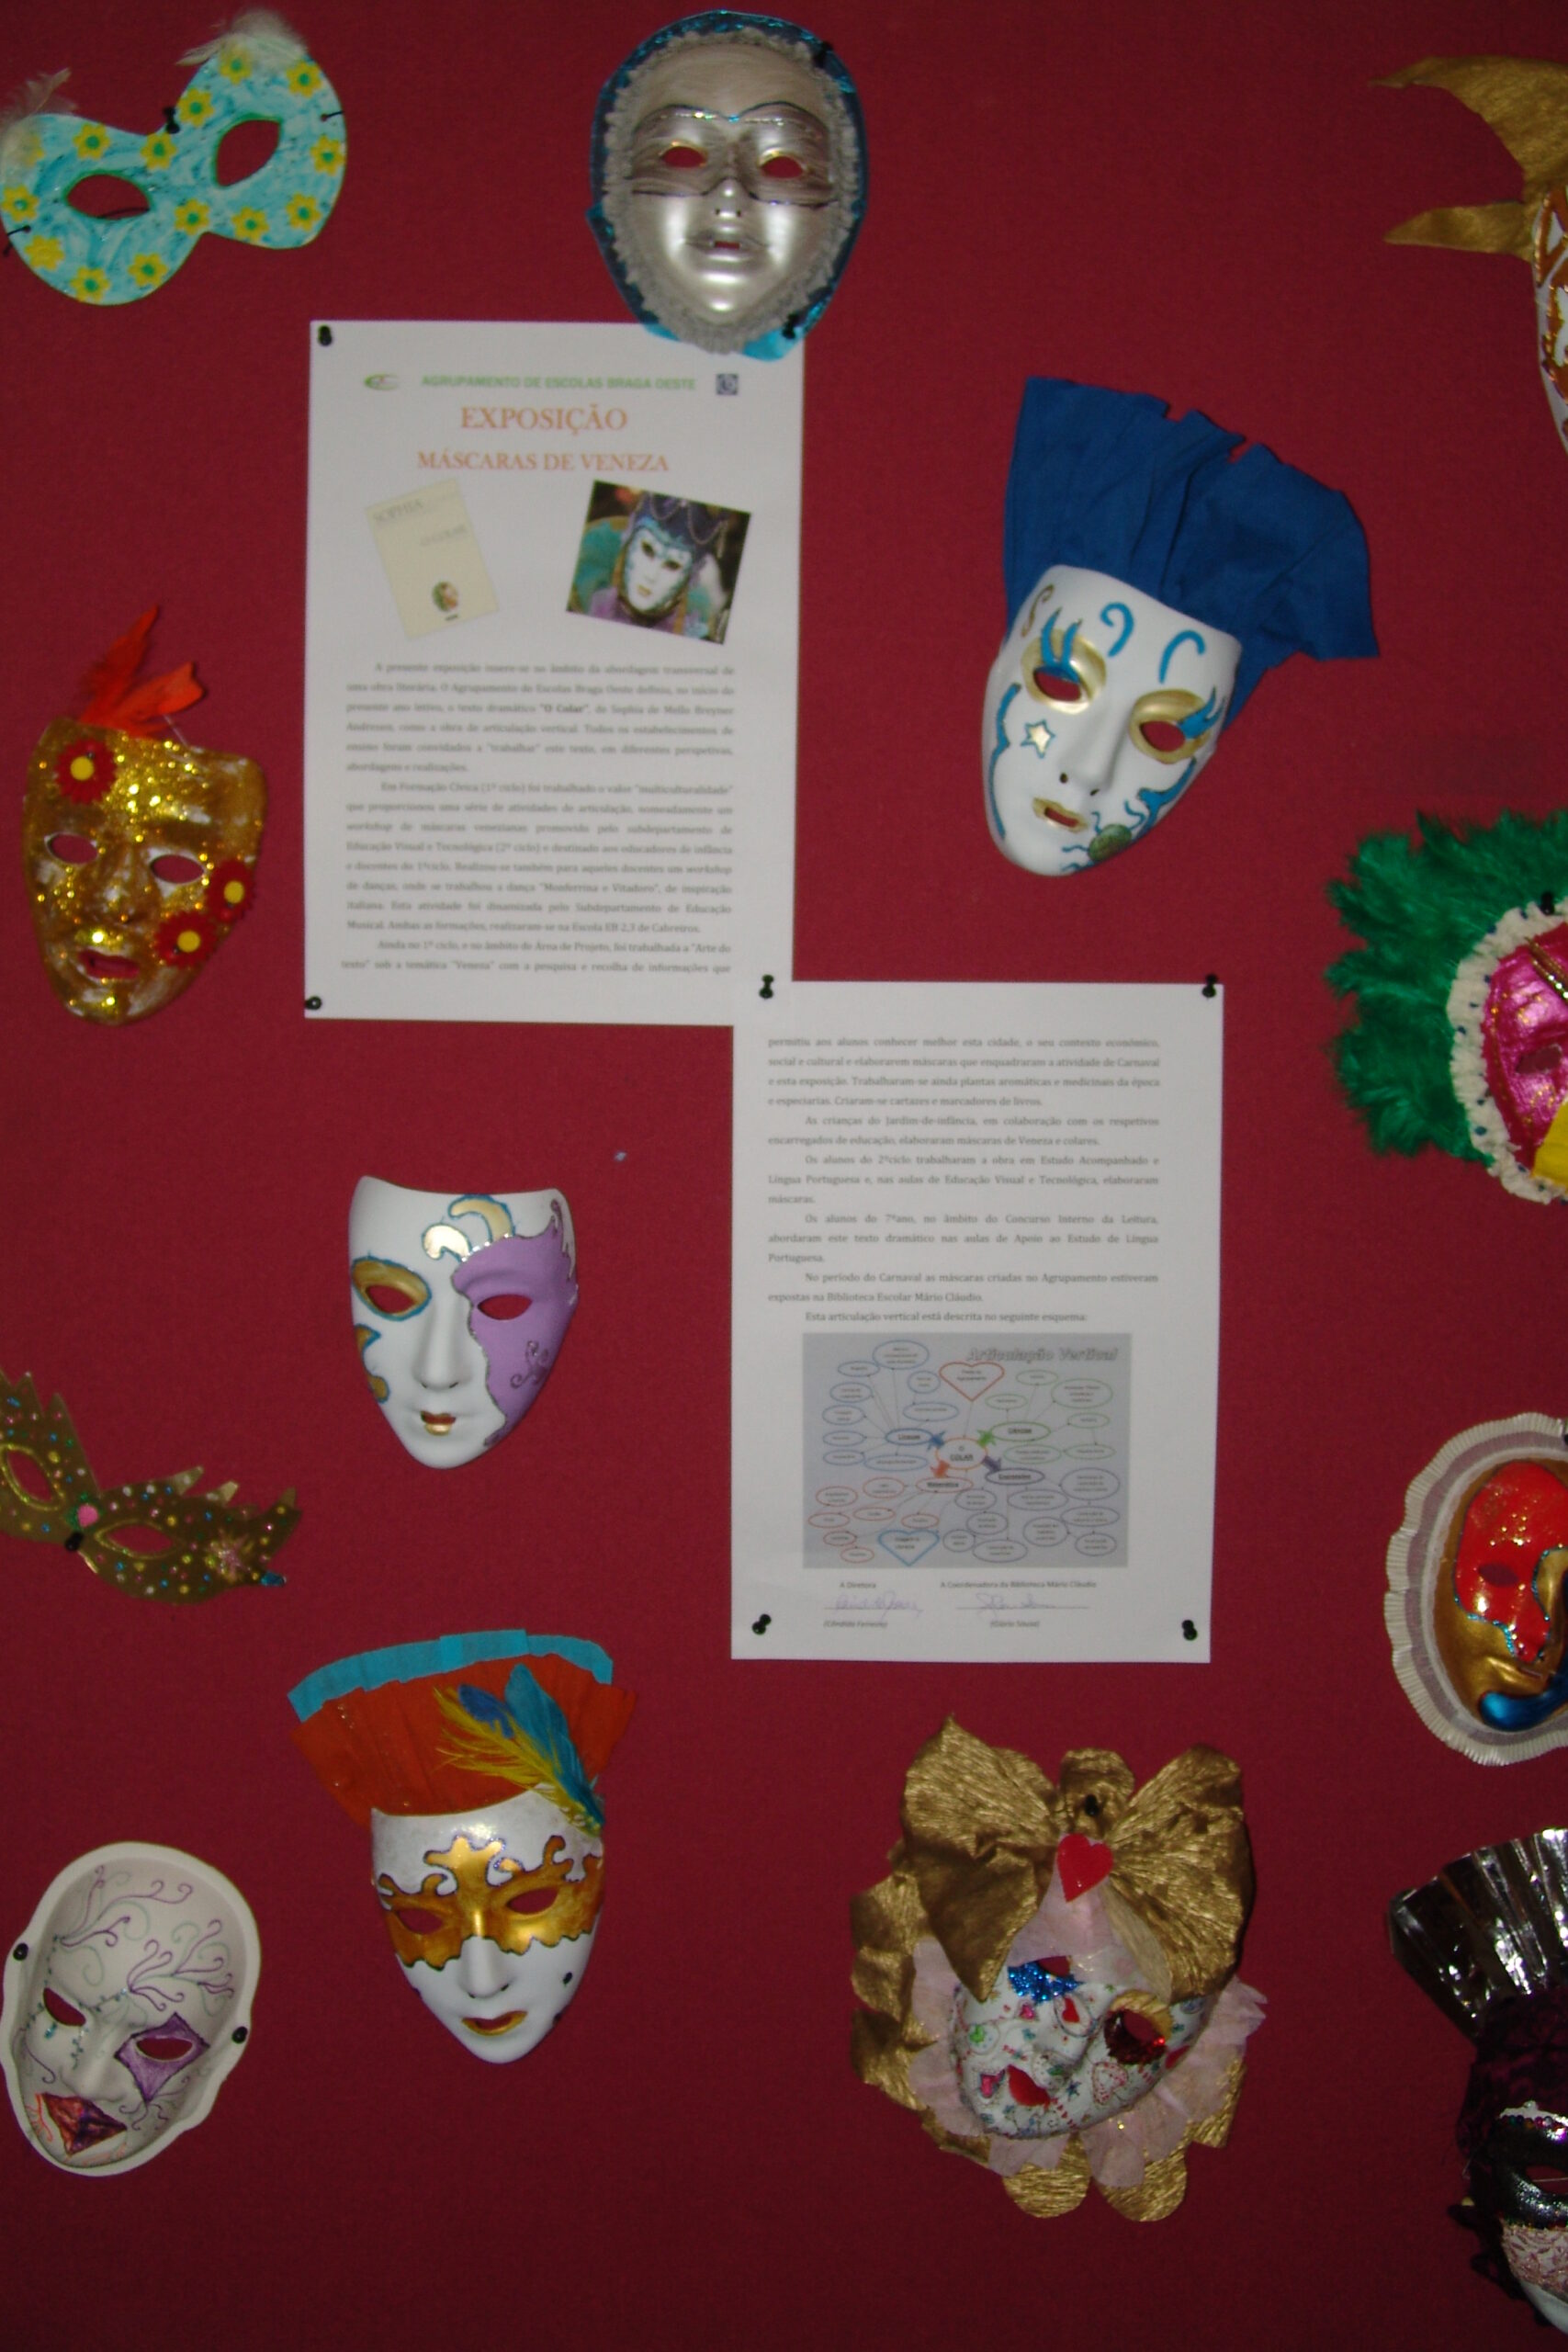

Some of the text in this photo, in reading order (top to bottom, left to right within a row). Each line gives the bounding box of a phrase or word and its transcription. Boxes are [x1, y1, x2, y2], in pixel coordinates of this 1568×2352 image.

[421, 375, 697, 390] AGRUPAMENTO DE ESCOLAS BRAGA OESTE
[460, 403, 628, 435] EXPOSIÇÃO
[416, 448, 669, 472] MÁSCARAS DE VENEZA
